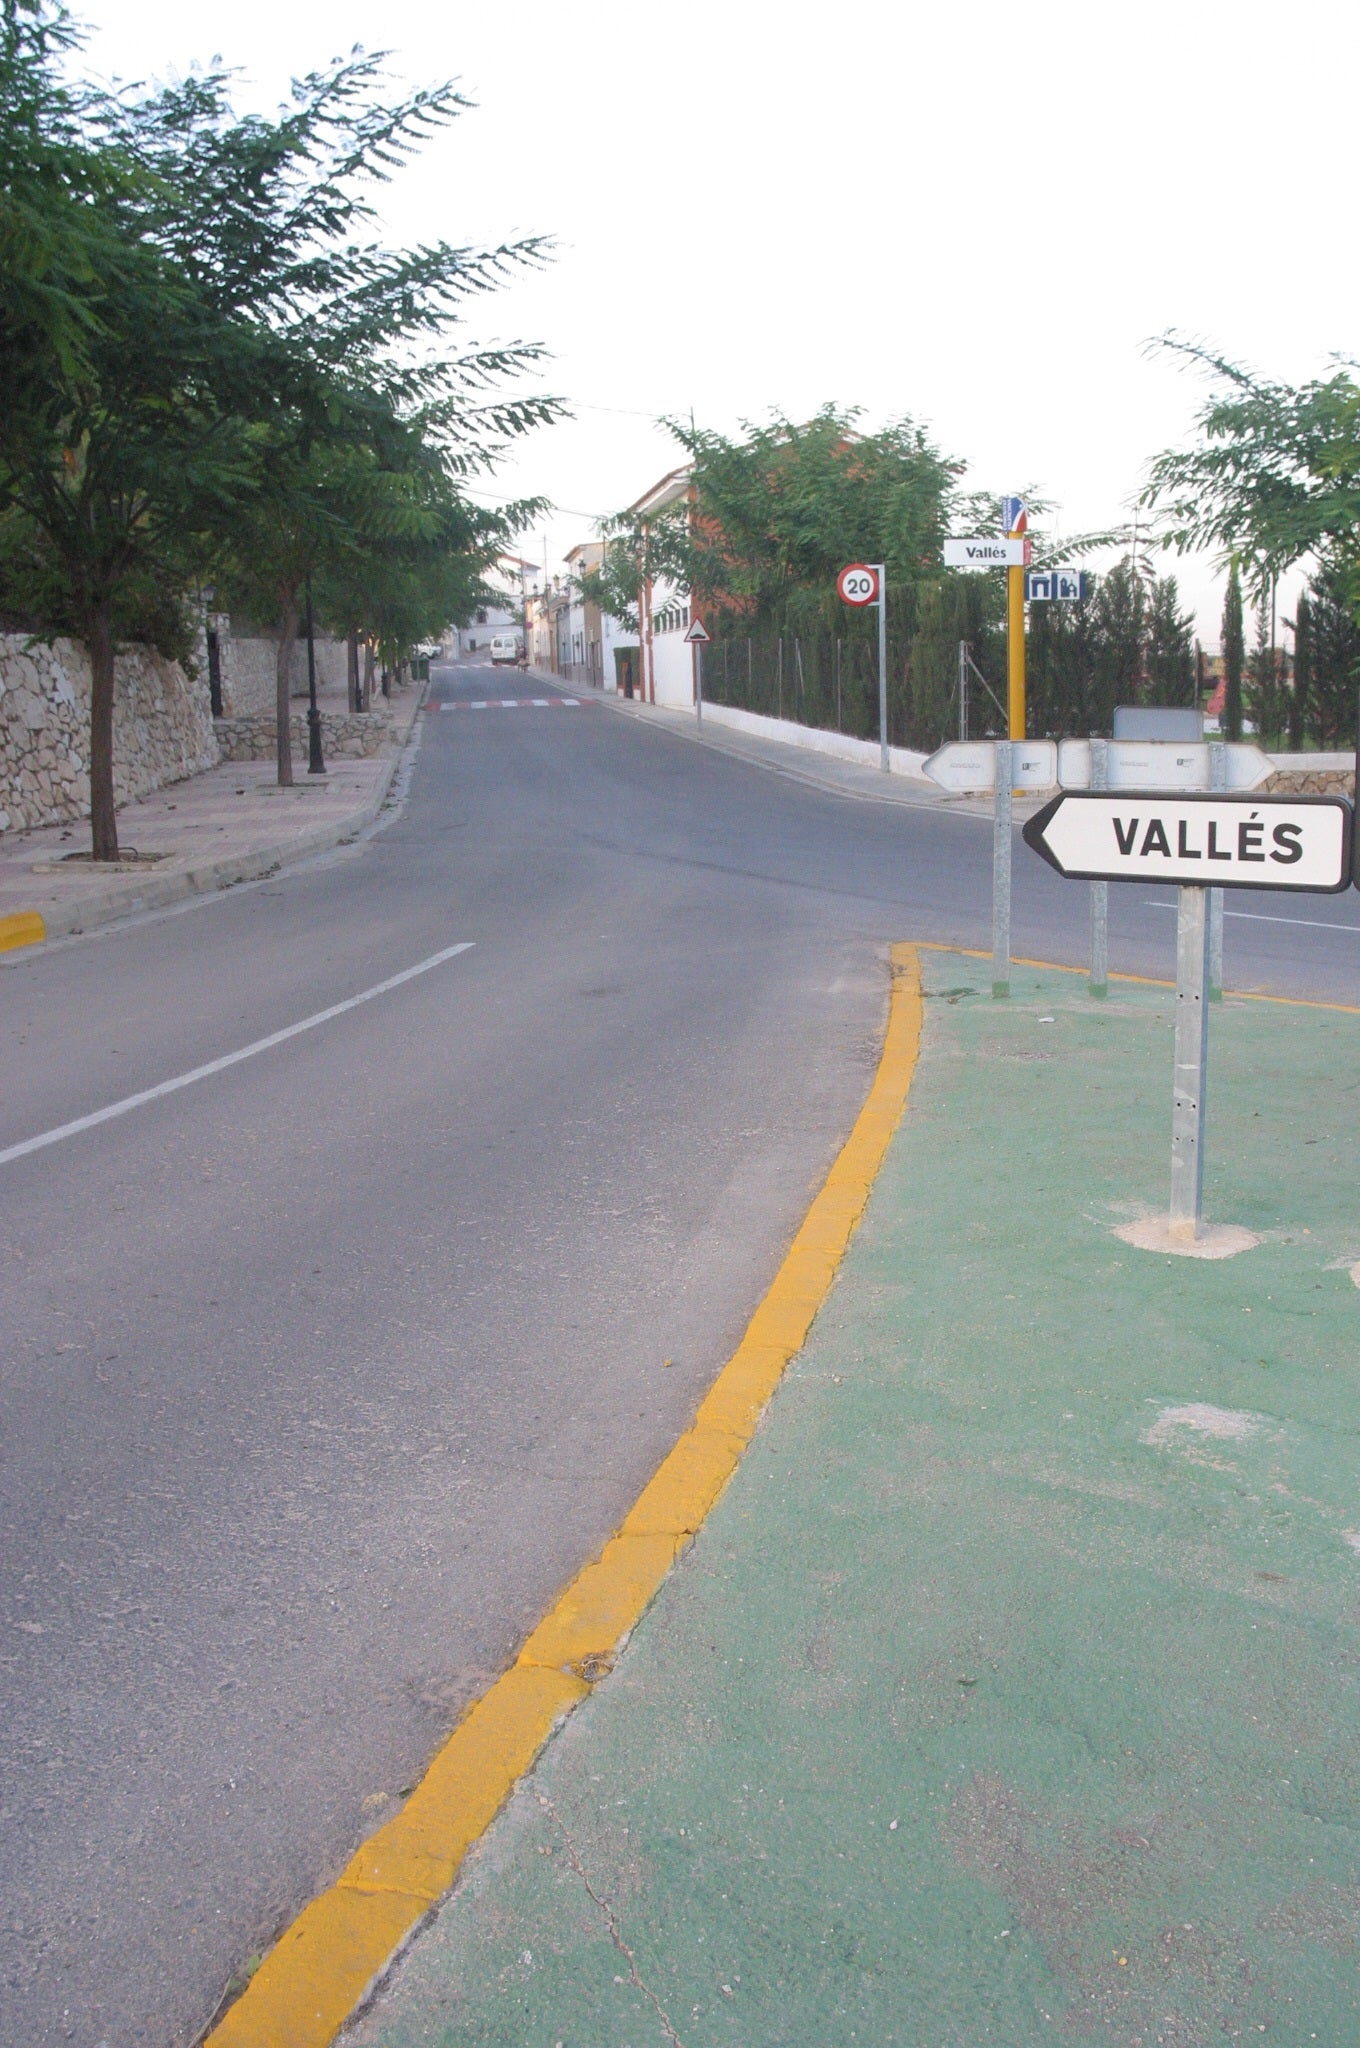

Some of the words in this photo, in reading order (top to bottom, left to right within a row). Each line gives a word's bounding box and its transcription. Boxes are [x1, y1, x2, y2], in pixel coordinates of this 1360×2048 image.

[966, 546, 1007, 559] Vallés
[847, 578, 870, 594] 20
[1112, 812, 1303, 864] VALLÉS
